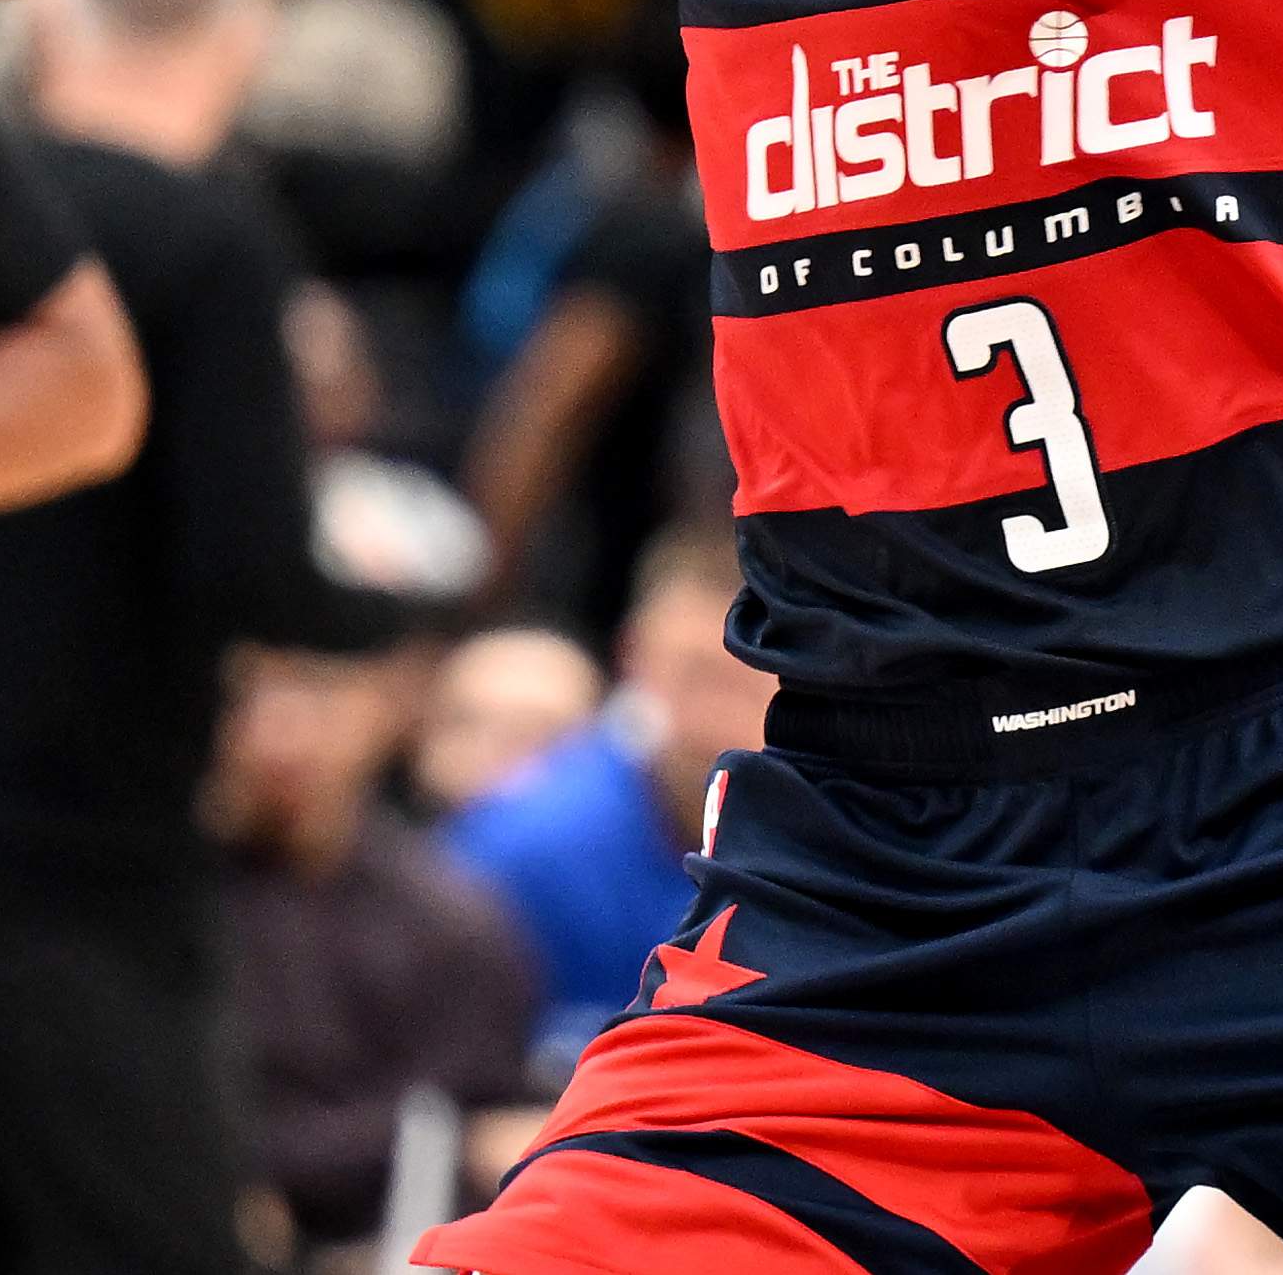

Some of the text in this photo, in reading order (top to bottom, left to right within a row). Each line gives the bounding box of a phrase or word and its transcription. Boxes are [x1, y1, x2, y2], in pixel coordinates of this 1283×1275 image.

[832, 51, 900, 96] THE
[746, 11, 1218, 221] district
[759, 258, 812, 295] OF
[945, 301, 1110, 574] 3
[992, 690, 1136, 733] WASHINGTON
